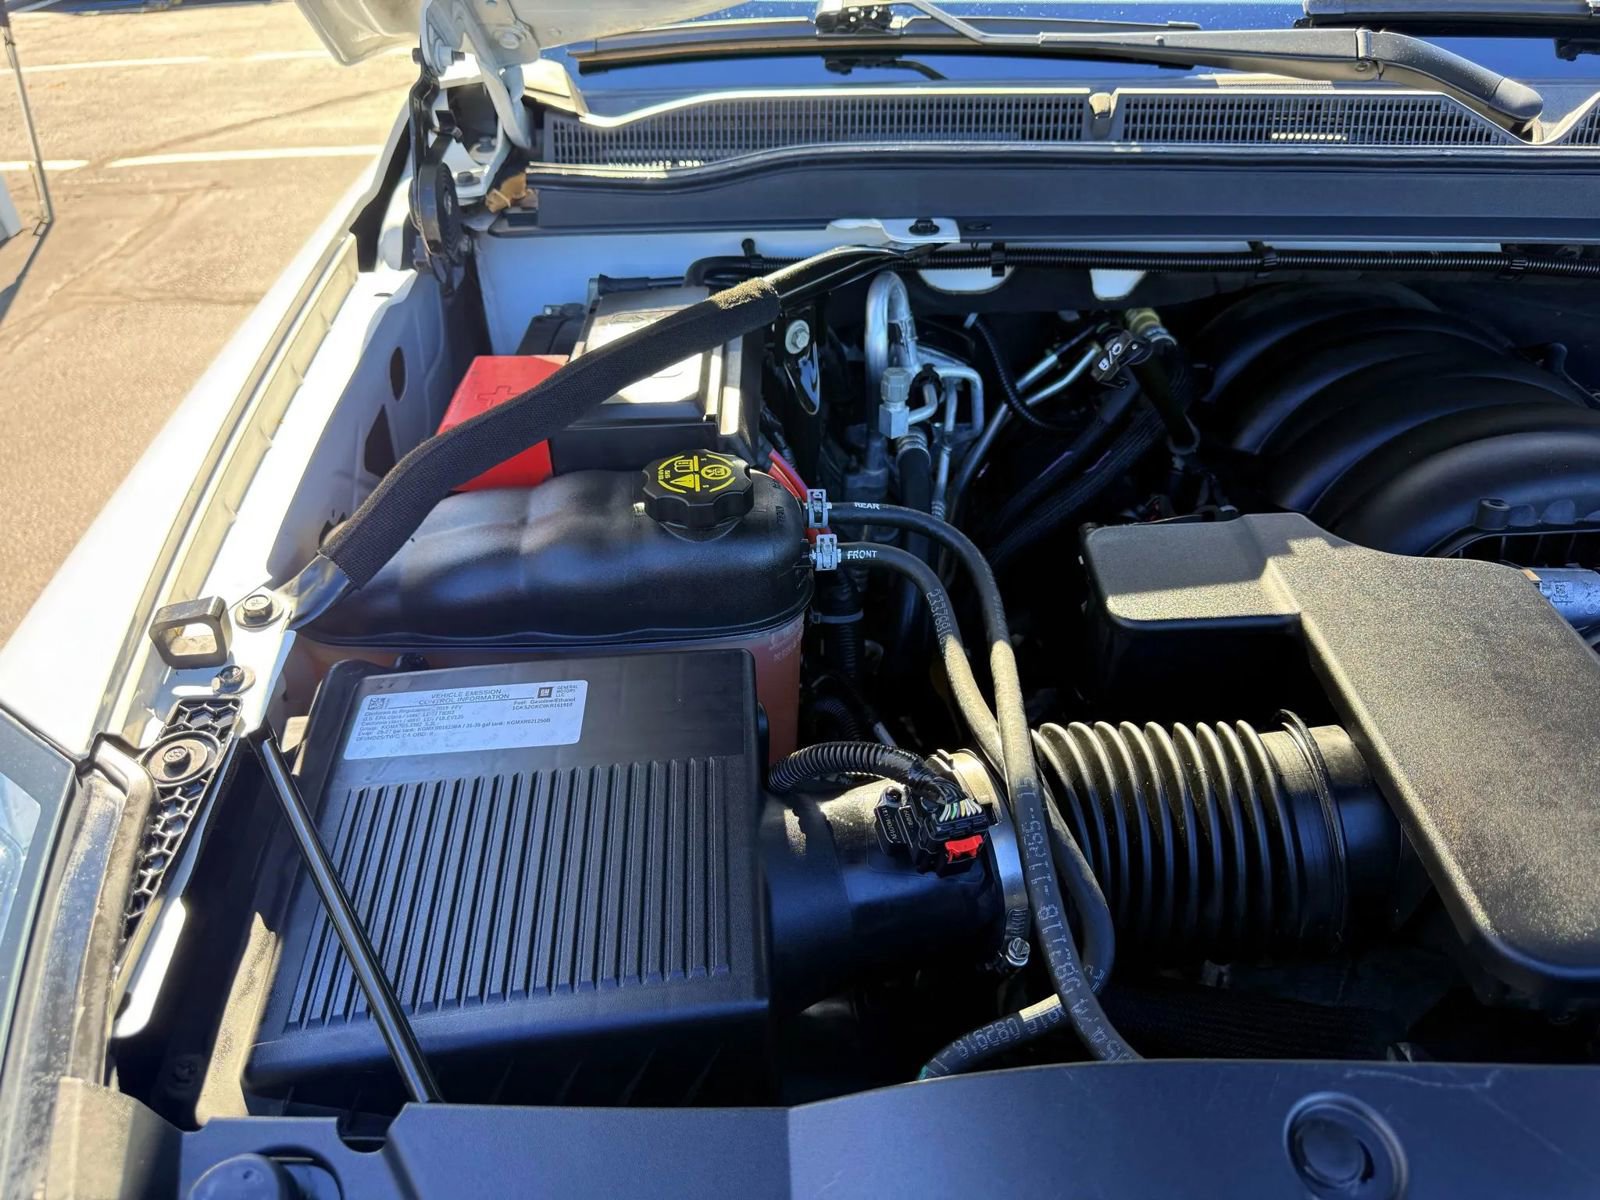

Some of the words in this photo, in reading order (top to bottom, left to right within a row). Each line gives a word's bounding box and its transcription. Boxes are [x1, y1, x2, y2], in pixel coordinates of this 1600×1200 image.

[854, 502, 881, 510] REAR
[847, 550, 878, 560] FRONT
[465, 689, 502, 697] EMISSION
[457, 694, 510, 702] INFORMATION
